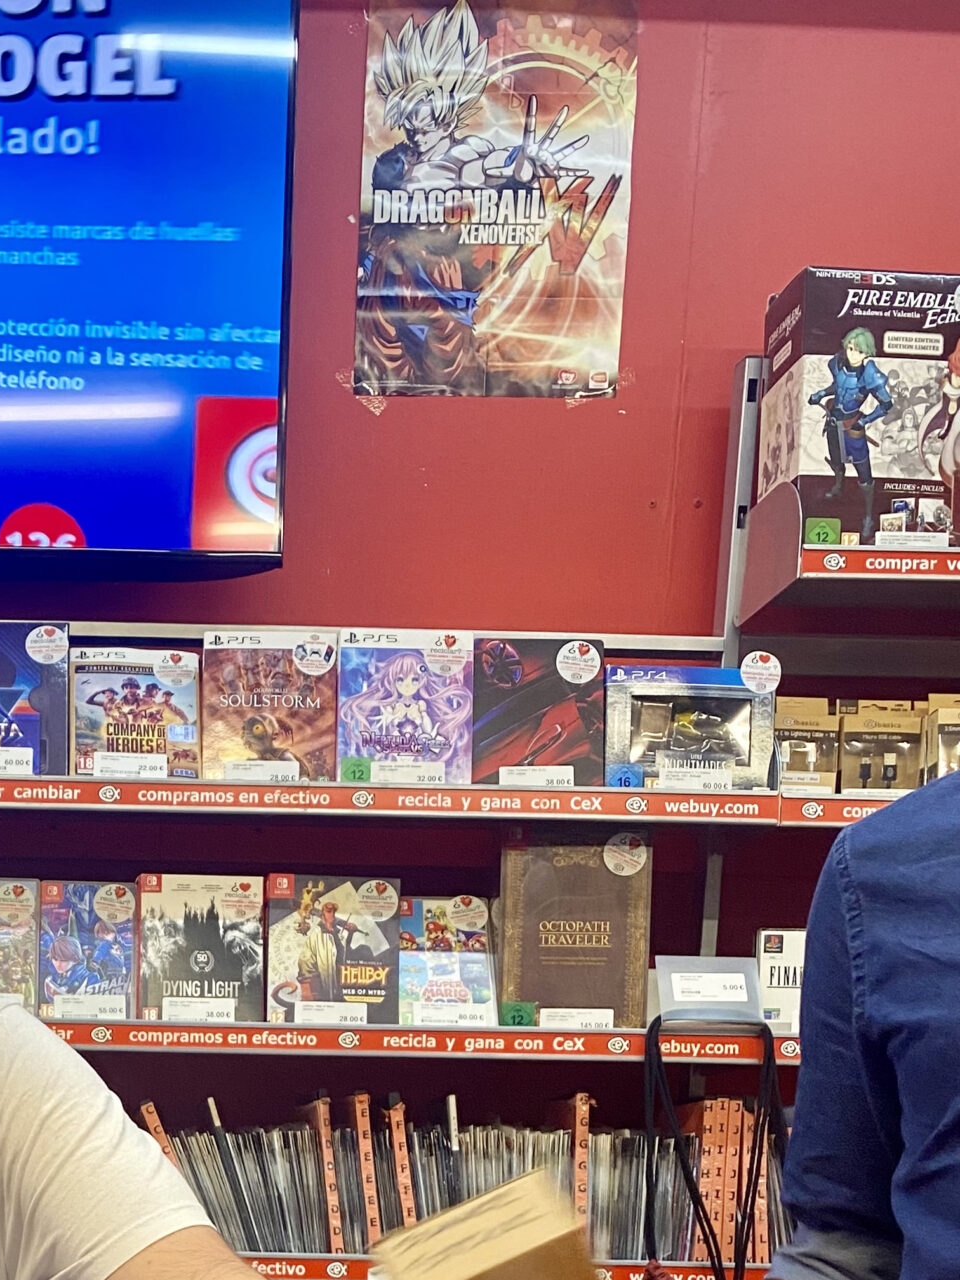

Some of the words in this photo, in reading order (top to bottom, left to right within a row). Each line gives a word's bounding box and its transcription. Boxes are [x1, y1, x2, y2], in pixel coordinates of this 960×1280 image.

[458, 224, 543, 245] XENOVERSE
[837, 288, 894, 318] FIRE
[84, 319, 170, 341] invisible
[174, 321, 205, 342] sin
[66, 346, 85, 365] ni
[89, 350, 101, 366] a
[106, 346, 125, 366] la
[130, 349, 232, 370] sensación
[235, 351, 263, 371] de
[815, 530, 829, 543] 12
[865, 556, 938, 573] comprar
[226, 636, 262, 645] PS5
[362, 633, 398, 644] PS5
[92, 650, 126, 660] PS5
[631, 669, 667, 680] PS4
[219, 693, 321, 709] SOULSTORM
[106, 722, 156, 738] COMPANY
[106, 737, 154, 753] HEROES
[156, 737, 167, 754] 3
[77, 755, 94, 770] 18
[617, 776, 631, 788] 16
[13, 784, 81, 800] cambiar
[137, 788, 235, 806] compramos
[238, 791, 259, 804] en
[263, 788, 331, 806] efectivo
[397, 792, 452, 808] recicla
[461, 796, 471, 811] y
[480, 796, 522, 812] gana
[531, 797, 560, 811] con
[570, 796, 603, 811] CeX
[664, 799, 760, 818] webuy.com
[538, 920, 611, 933] OCTOPATH
[538, 933, 610, 946] TRAVELER
[340, 965, 390, 986] HELLBOY
[162, 979, 201, 998] DYING
[203, 976, 242, 998] LIGHT
[342, 988, 356, 996] WEB
[357, 988, 367, 996] OF
[128, 1029, 223, 1046] compramos
[227, 1031, 248, 1045] en
[251, 1030, 318, 1047] efectivo
[382, 1033, 437, 1049] recicla
[445, 1036, 456, 1052] y
[464, 1036, 506, 1053] gana
[513, 1036, 544, 1051] con
[552, 1036, 585, 1052] CeX
[658, 1039, 740, 1057] ebuy.com
[251, 1260, 306, 1277] fectivo
